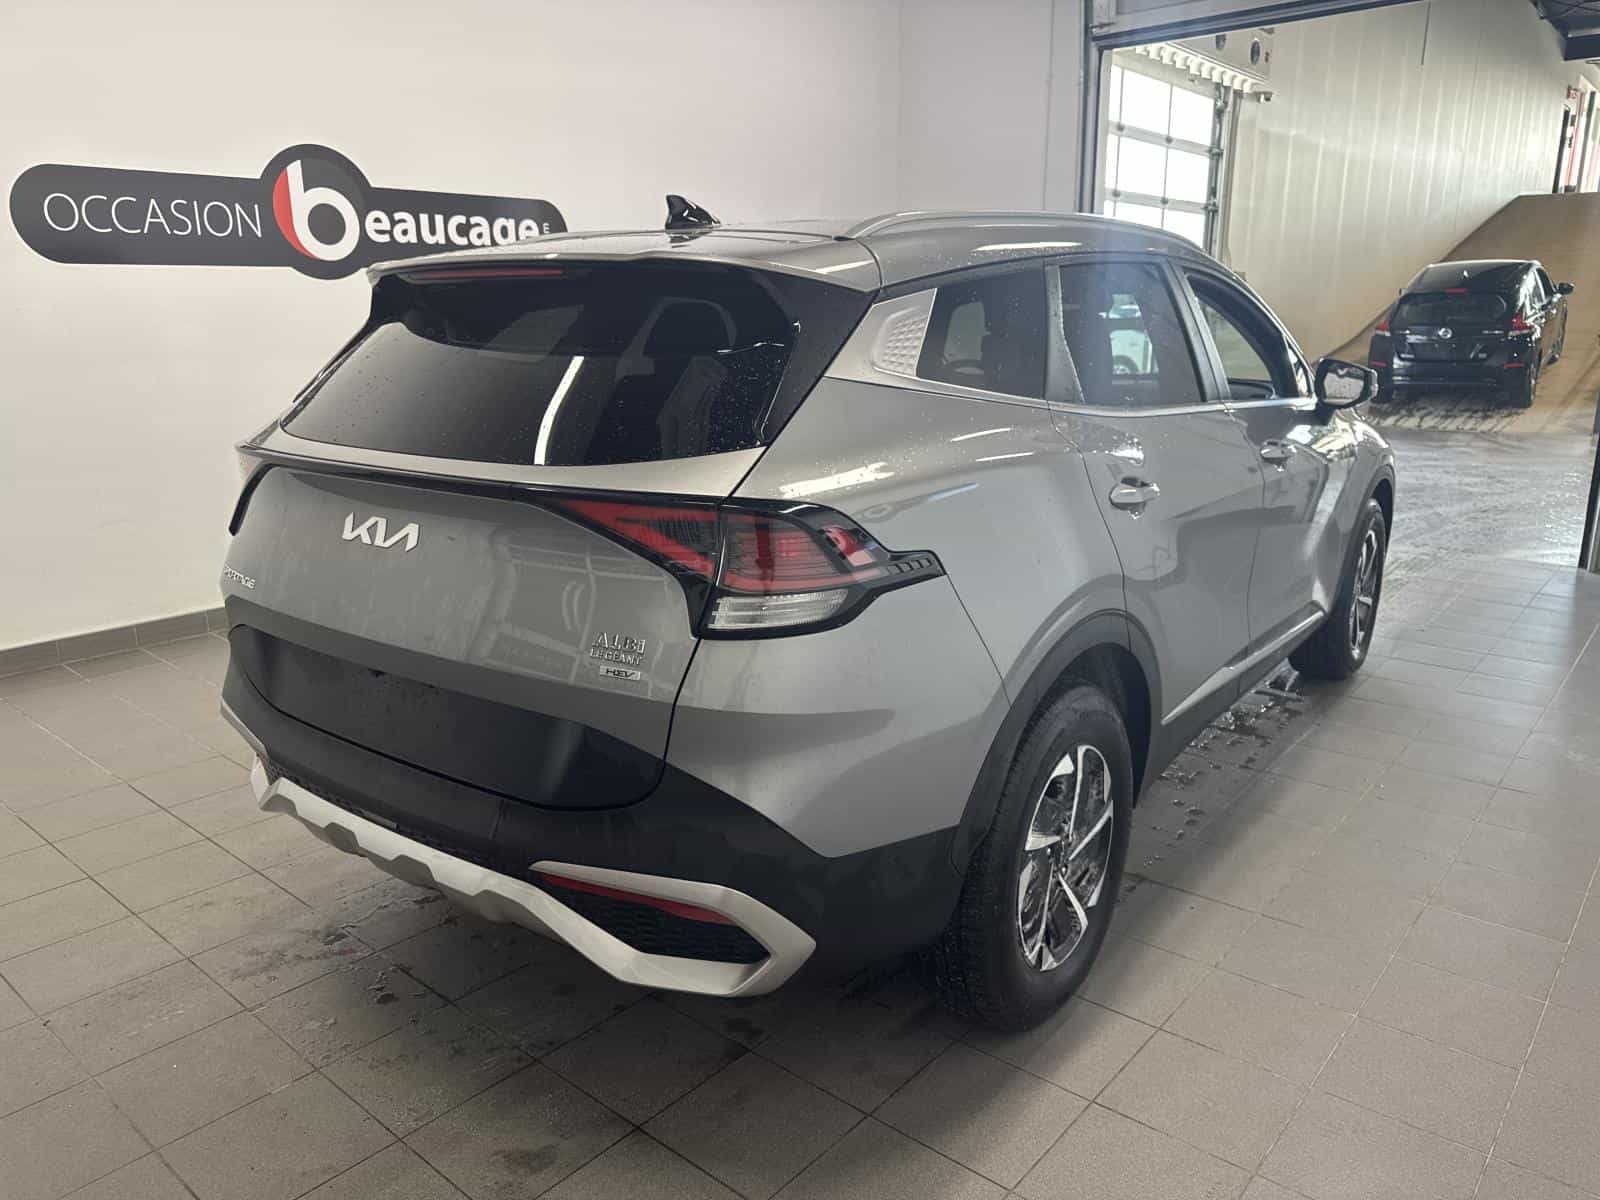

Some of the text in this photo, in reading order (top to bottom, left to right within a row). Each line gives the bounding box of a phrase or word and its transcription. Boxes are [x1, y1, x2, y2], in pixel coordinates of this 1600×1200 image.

[43, 192, 263, 239] OCCASION
[342, 511, 420, 552] KIA
[606, 668, 636, 678] HEV
